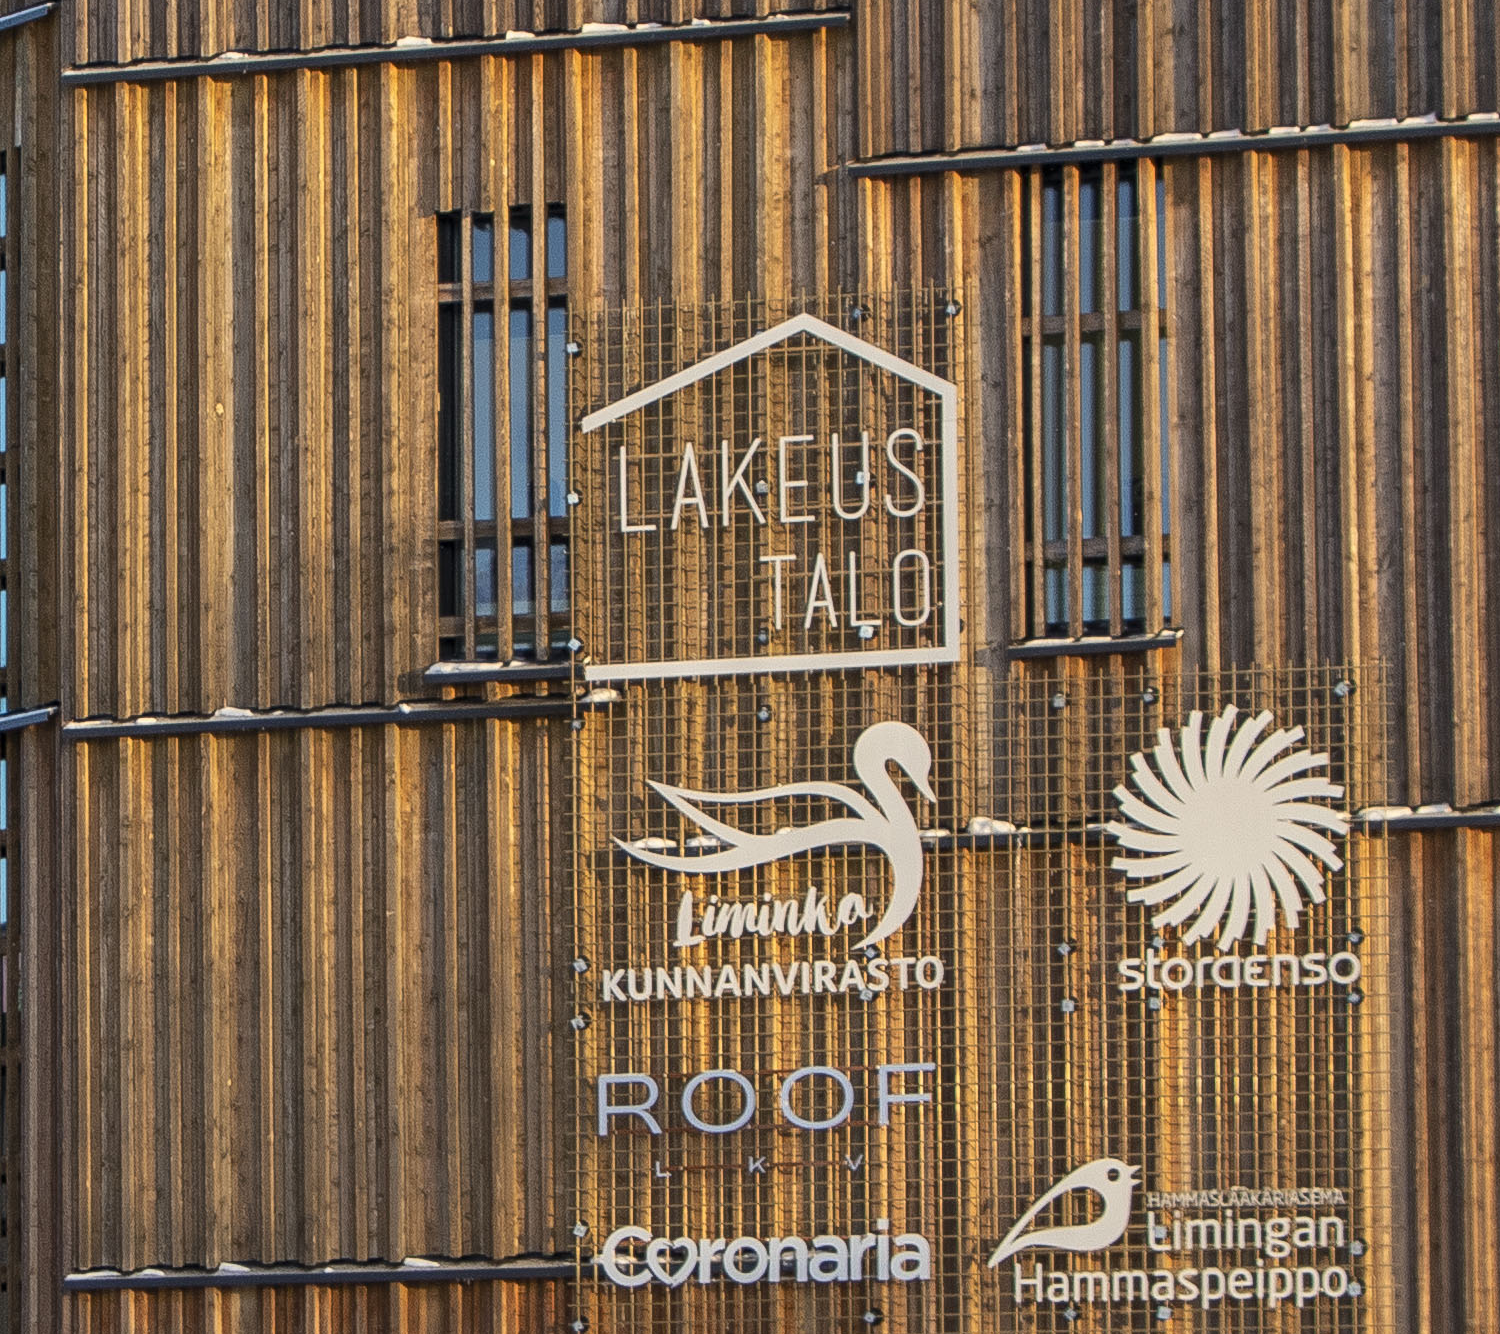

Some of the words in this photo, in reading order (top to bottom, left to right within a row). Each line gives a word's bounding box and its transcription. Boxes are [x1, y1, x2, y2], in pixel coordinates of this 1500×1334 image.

[619, 427, 926, 533] LAKEUS
[759, 548, 931, 630] TALO
[673, 885, 873, 947] Liminka
[602, 955, 945, 1002] KUNNANVIRASTO
[598, 1062, 936, 1136] ROOF
[1146, 1208, 1345, 1258] Limingan
[1013, 1258, 1348, 1309] Hammaspeippo
